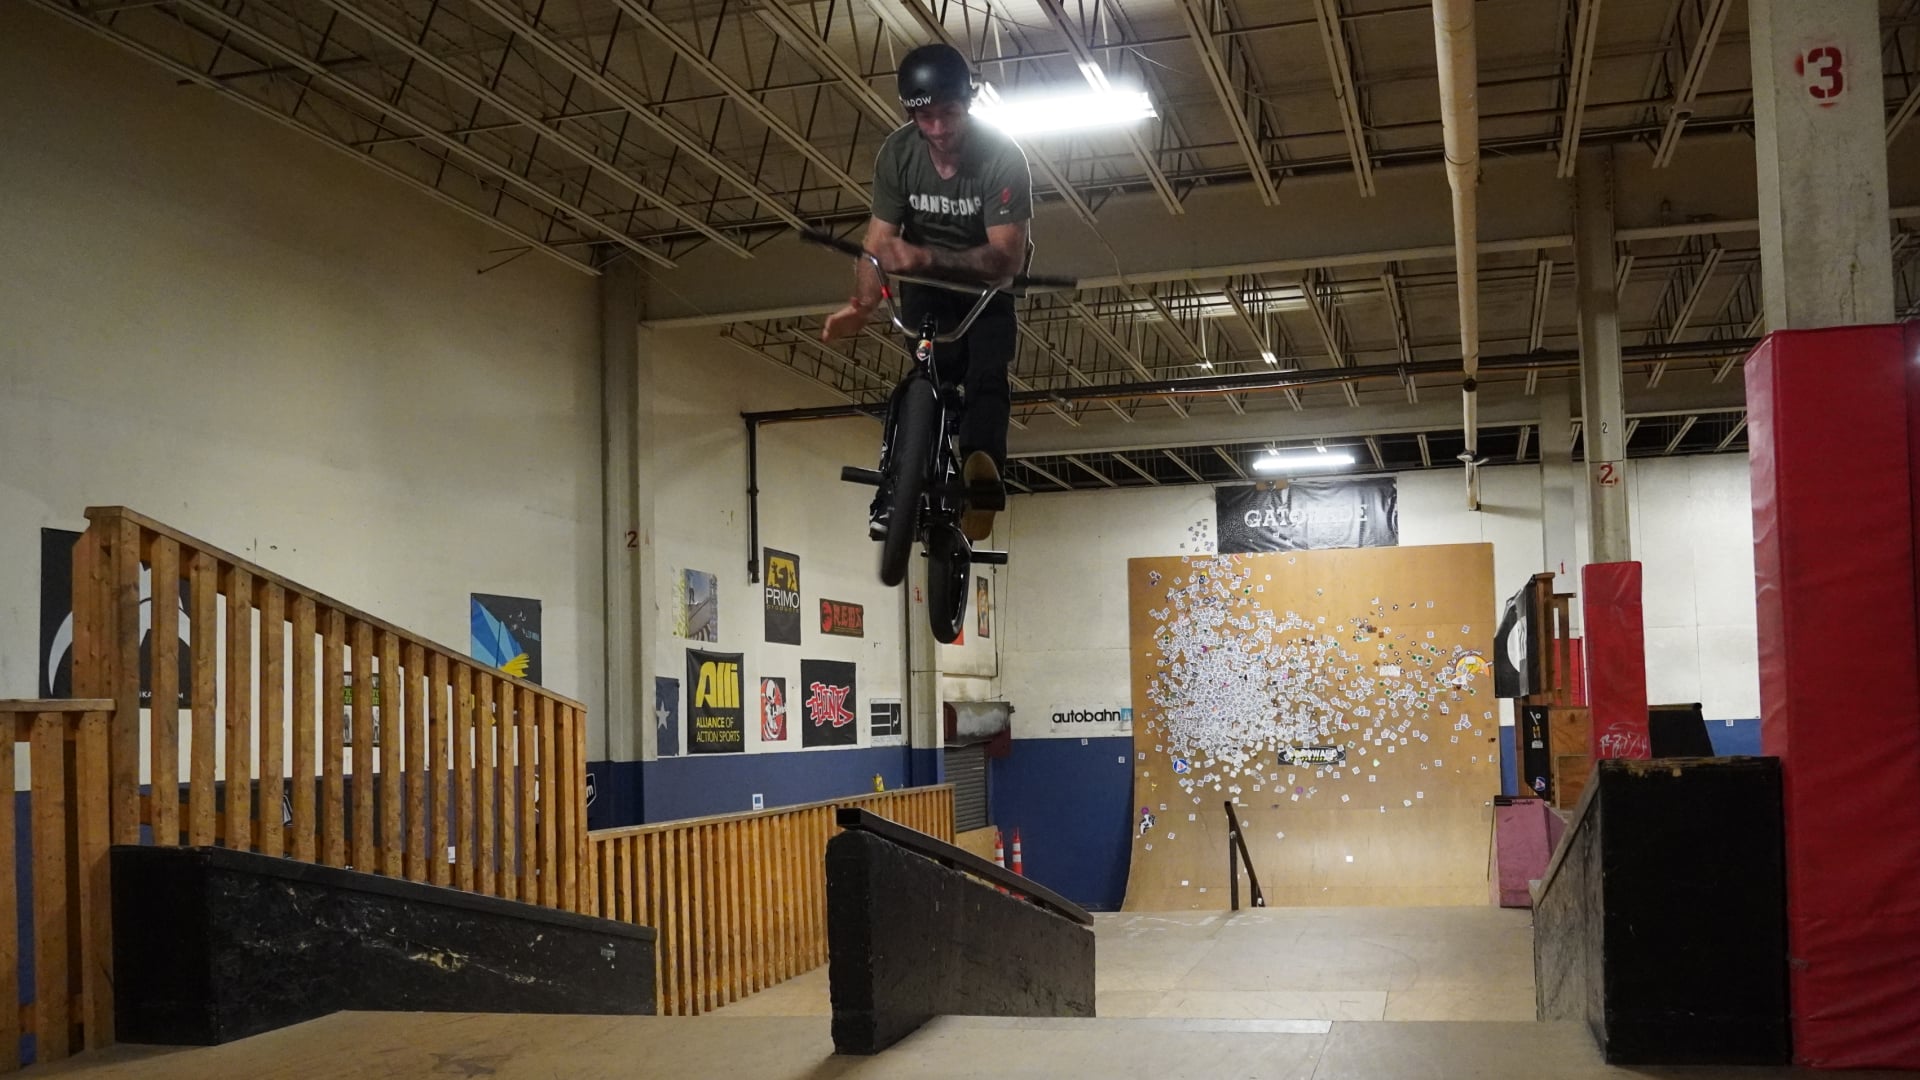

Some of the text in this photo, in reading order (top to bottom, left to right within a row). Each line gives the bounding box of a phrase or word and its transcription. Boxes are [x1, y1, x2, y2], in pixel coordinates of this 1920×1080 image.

[1807, 46, 1844, 99] 3
[1601, 421, 1609, 434] 2
[1599, 463, 1614, 484] 2
[627, 530, 638, 549] 2
[765, 586, 800, 609] PRIMO
[805, 681, 855, 728] THINK
[696, 716, 734, 729] ALLIANCE OF
[1052, 708, 1121, 723] autobahn
[696, 730, 740, 743] ACTION SPORTS
